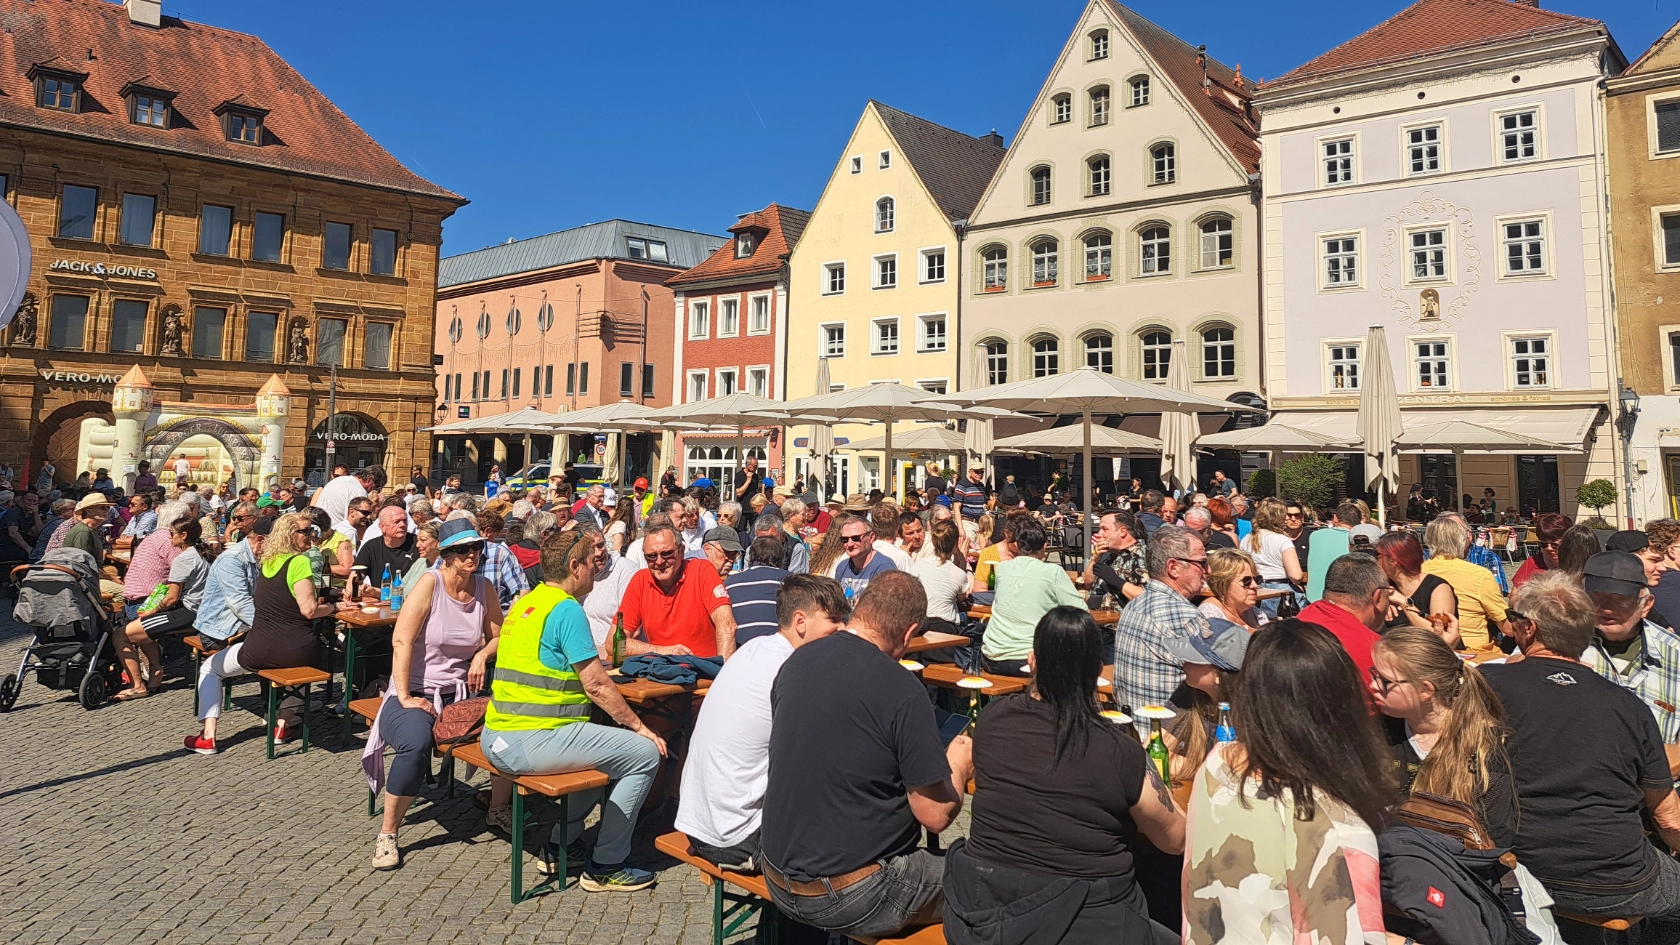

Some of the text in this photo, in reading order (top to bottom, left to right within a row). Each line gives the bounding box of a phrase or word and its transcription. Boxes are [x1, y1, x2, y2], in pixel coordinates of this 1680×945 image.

[50, 259, 156, 279] JACK & JONES
[43, 371, 91, 382] VERO
[317, 432, 385, 441] VERO MODA
